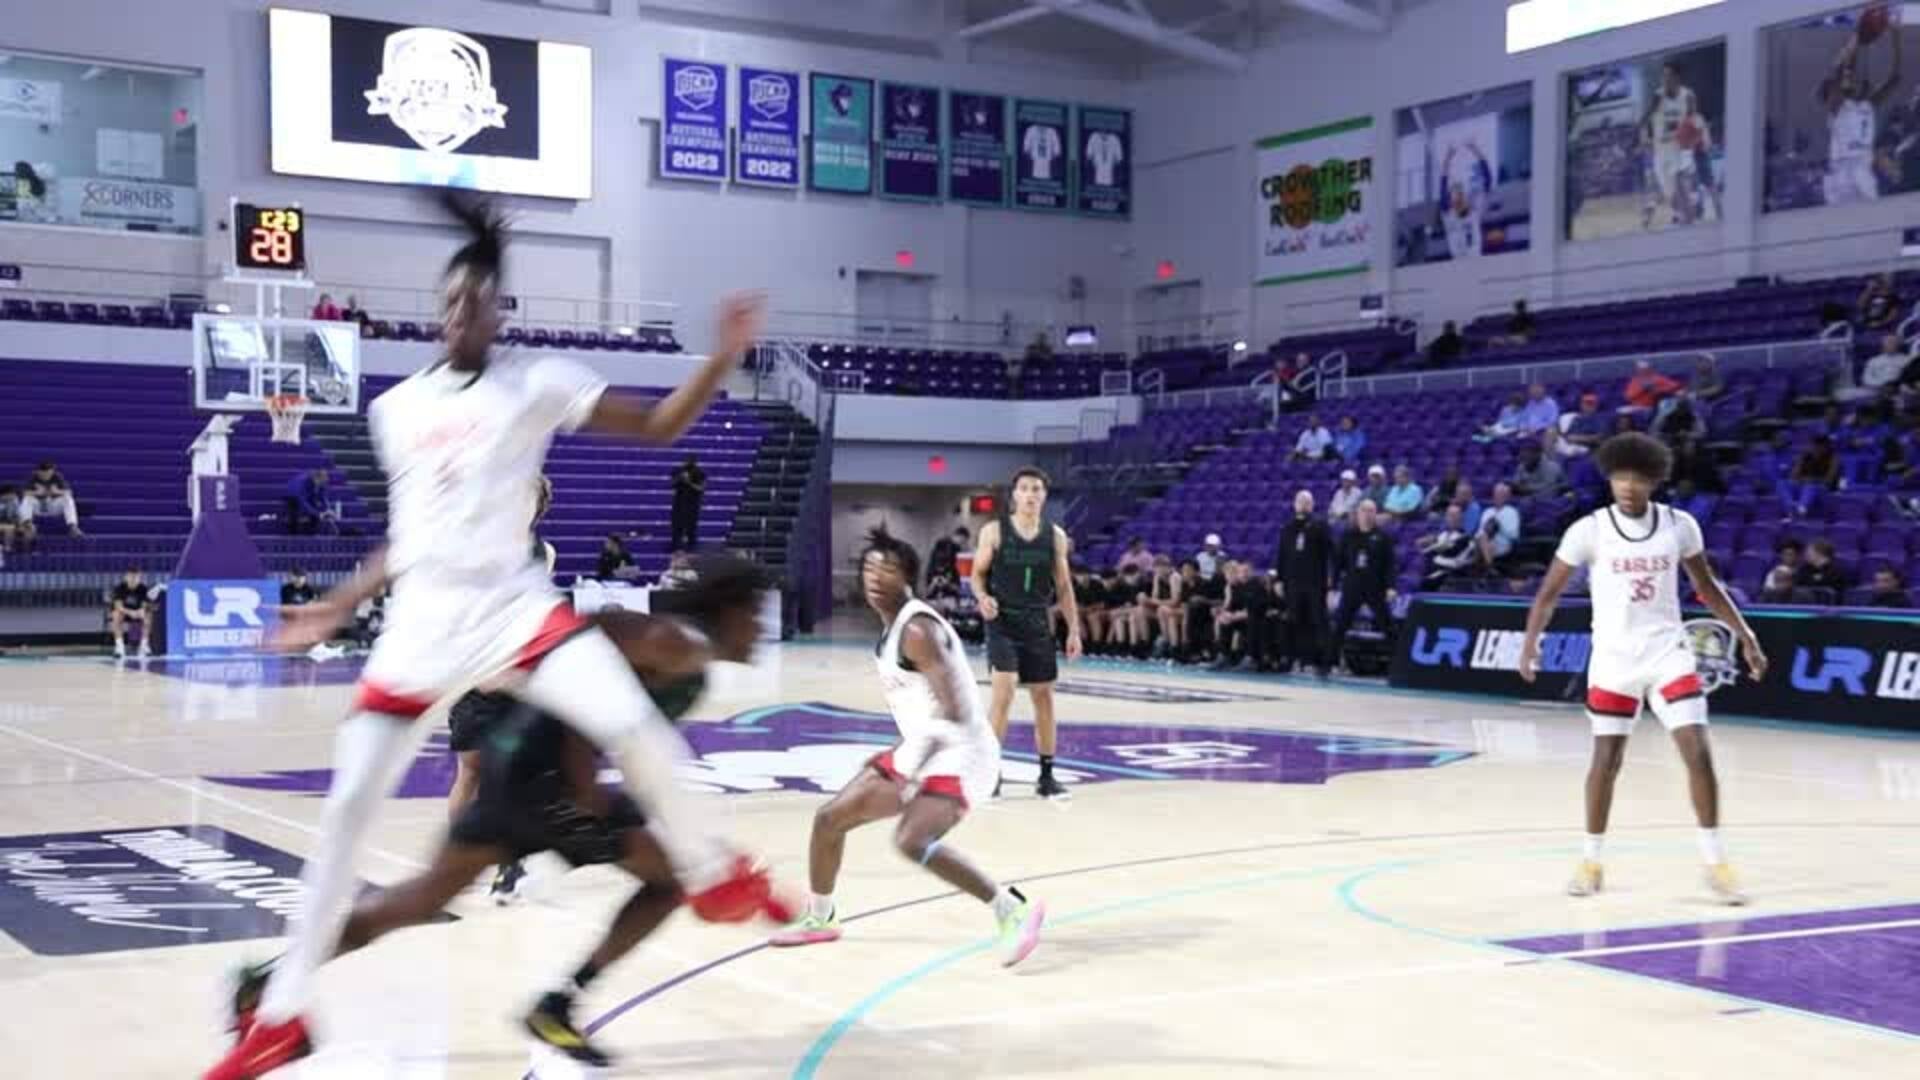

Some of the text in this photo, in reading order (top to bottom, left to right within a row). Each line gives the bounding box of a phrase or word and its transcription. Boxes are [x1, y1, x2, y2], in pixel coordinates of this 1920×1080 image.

[673, 151, 719, 171] 2023
[747, 159, 791, 178] 2022
[1261, 157, 1372, 200] CROWTHER
[1269, 190, 1361, 228] ROOFING
[250, 228, 292, 263] 28
[1612, 556, 1671, 574] EAGLES
[1629, 576, 1656, 602] 35
